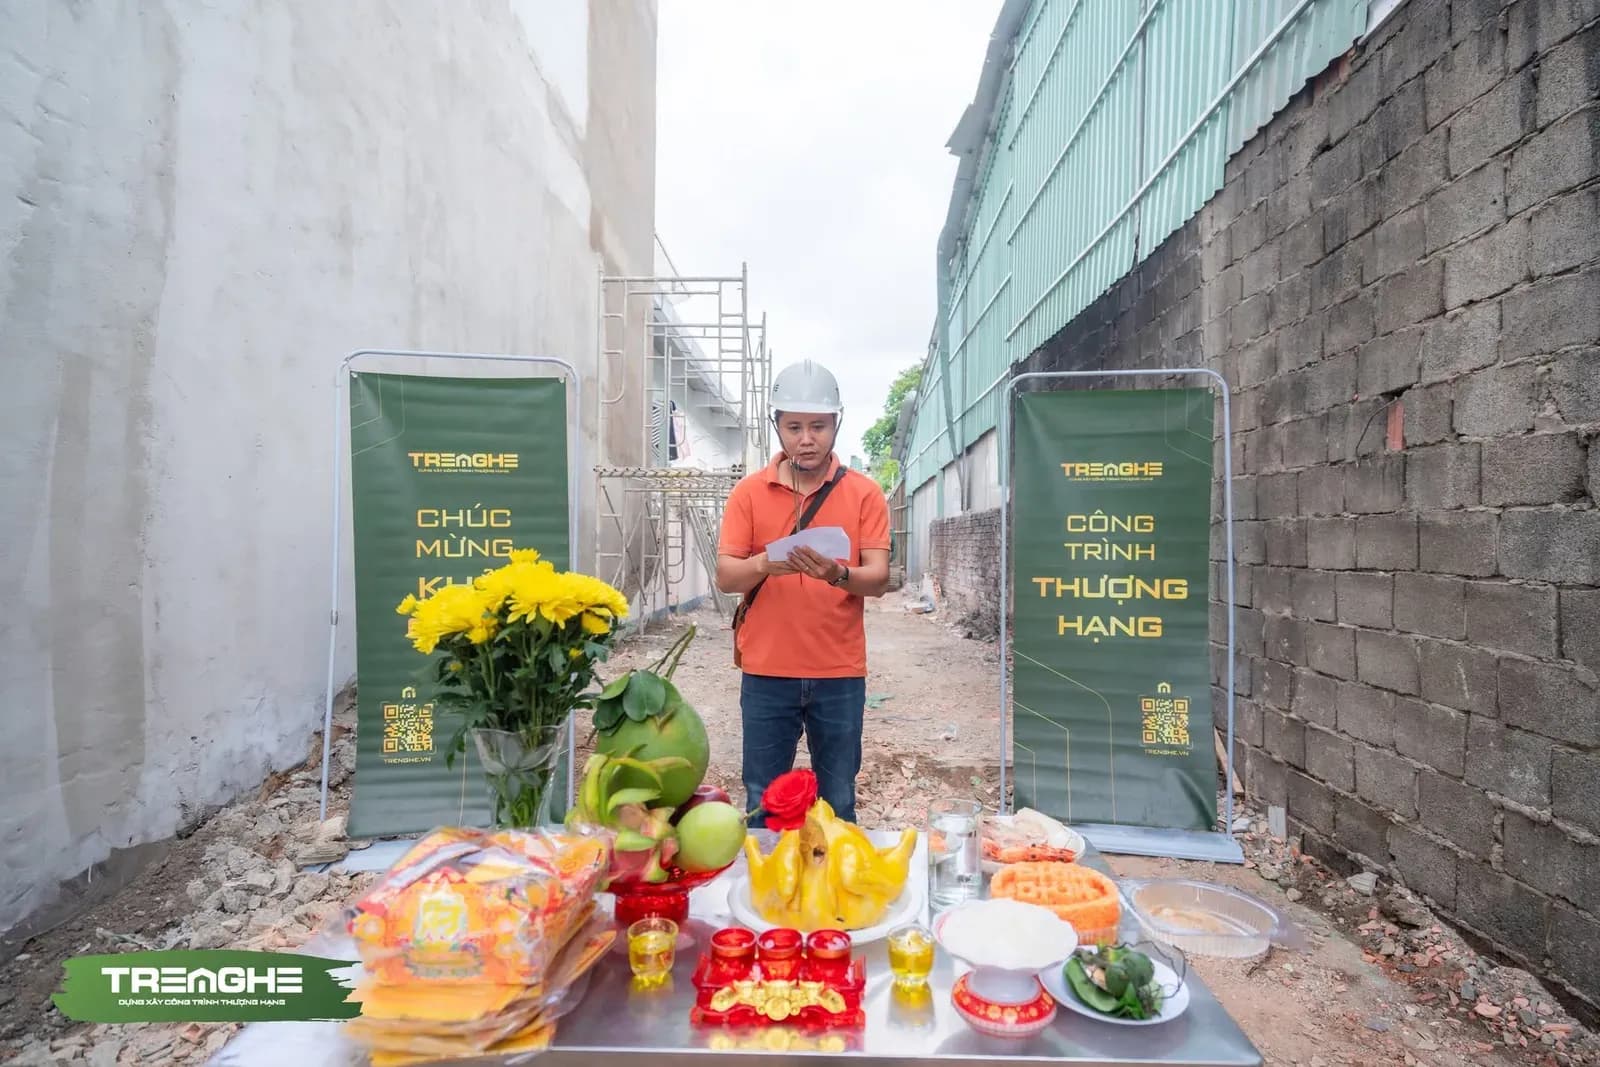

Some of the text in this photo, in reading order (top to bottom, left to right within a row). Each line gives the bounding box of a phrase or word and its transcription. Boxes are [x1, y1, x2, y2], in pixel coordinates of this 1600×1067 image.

[417, 503, 512, 528] CHÚC
[1067, 509, 1155, 532] CÔNG
[416, 533, 514, 558] MỪNG
[1064, 537, 1155, 560] TRÌNH
[1032, 574, 1188, 605] THƯỢNG
[1058, 615, 1163, 643] HẠNG
